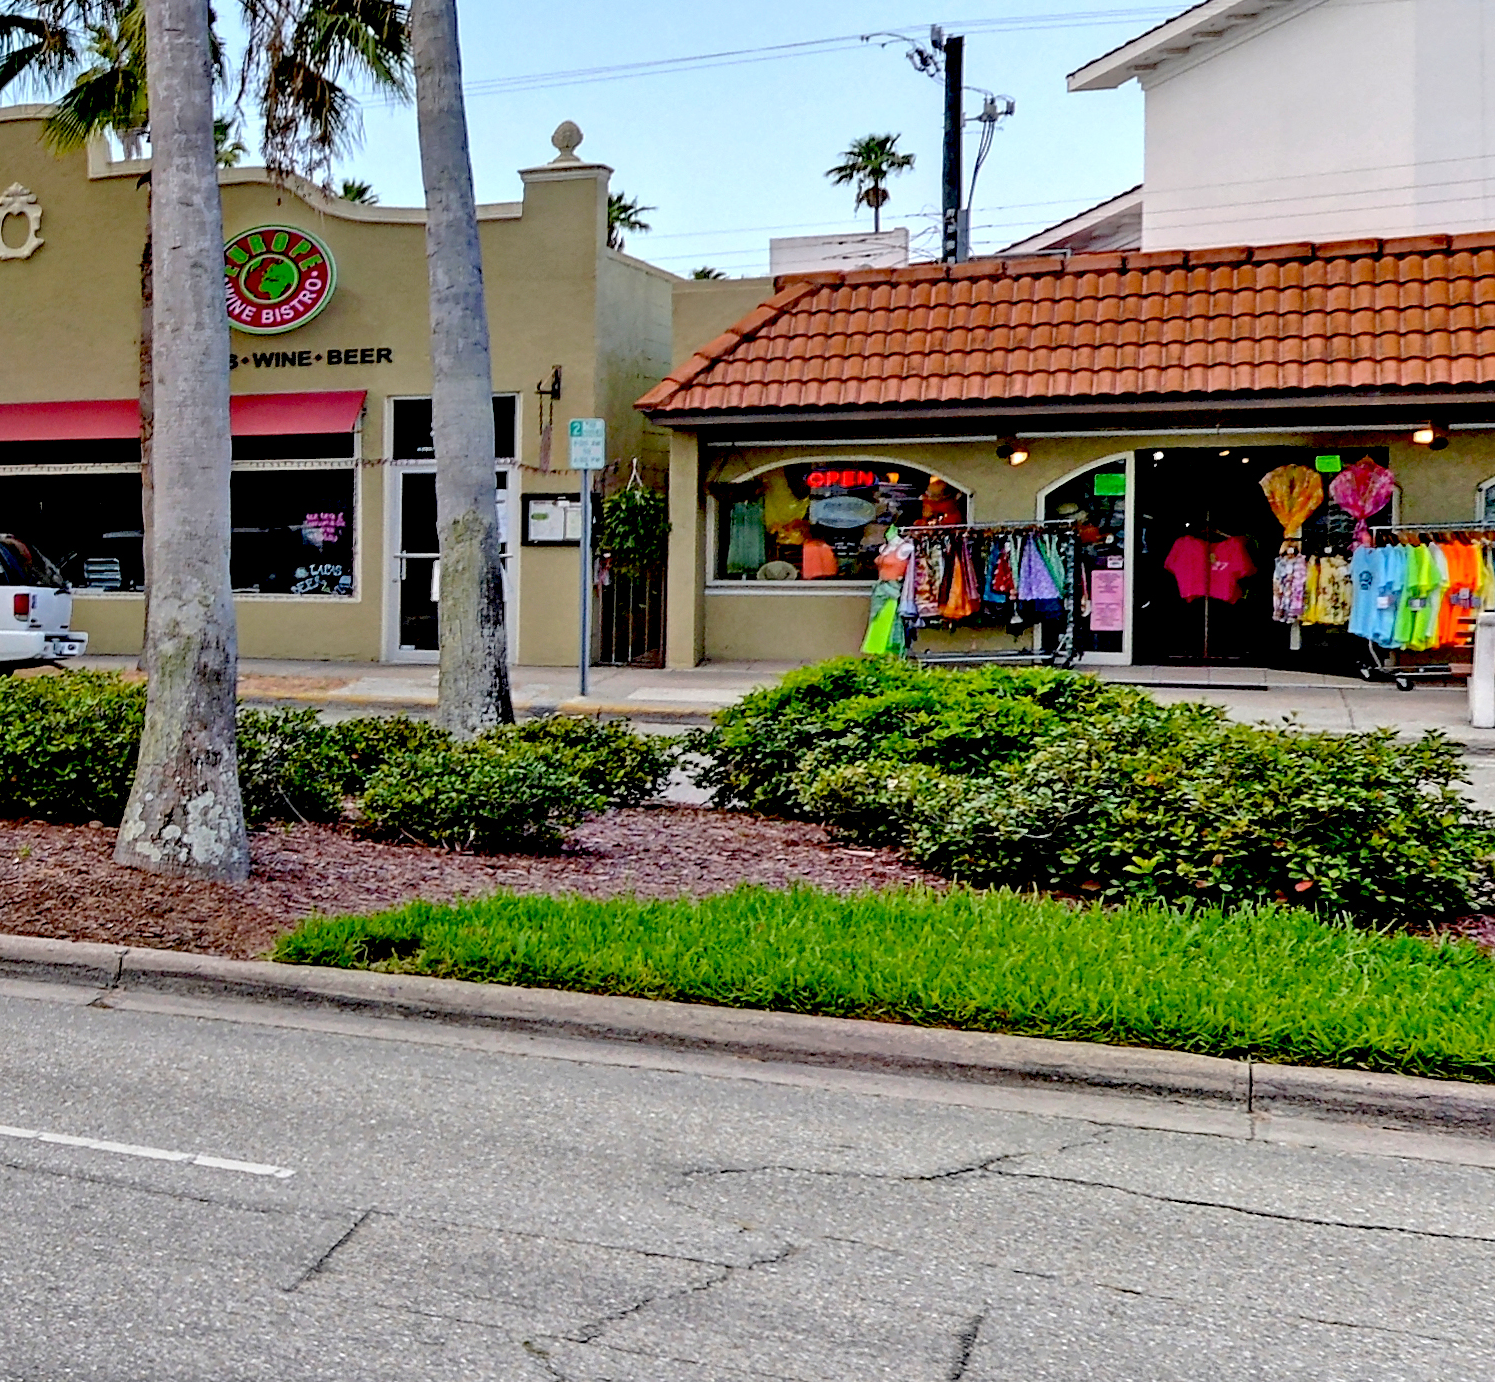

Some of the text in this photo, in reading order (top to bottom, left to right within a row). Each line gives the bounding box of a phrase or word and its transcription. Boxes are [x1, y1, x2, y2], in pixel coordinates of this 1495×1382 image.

[225, 232, 323, 277] EUROPE
[261, 278, 323, 324] BISTRO
[252, 350, 313, 368] WINE
[326, 348, 393, 365] BEER
[572, 421, 582, 436] 2
[807, 470, 874, 488] OPEN
